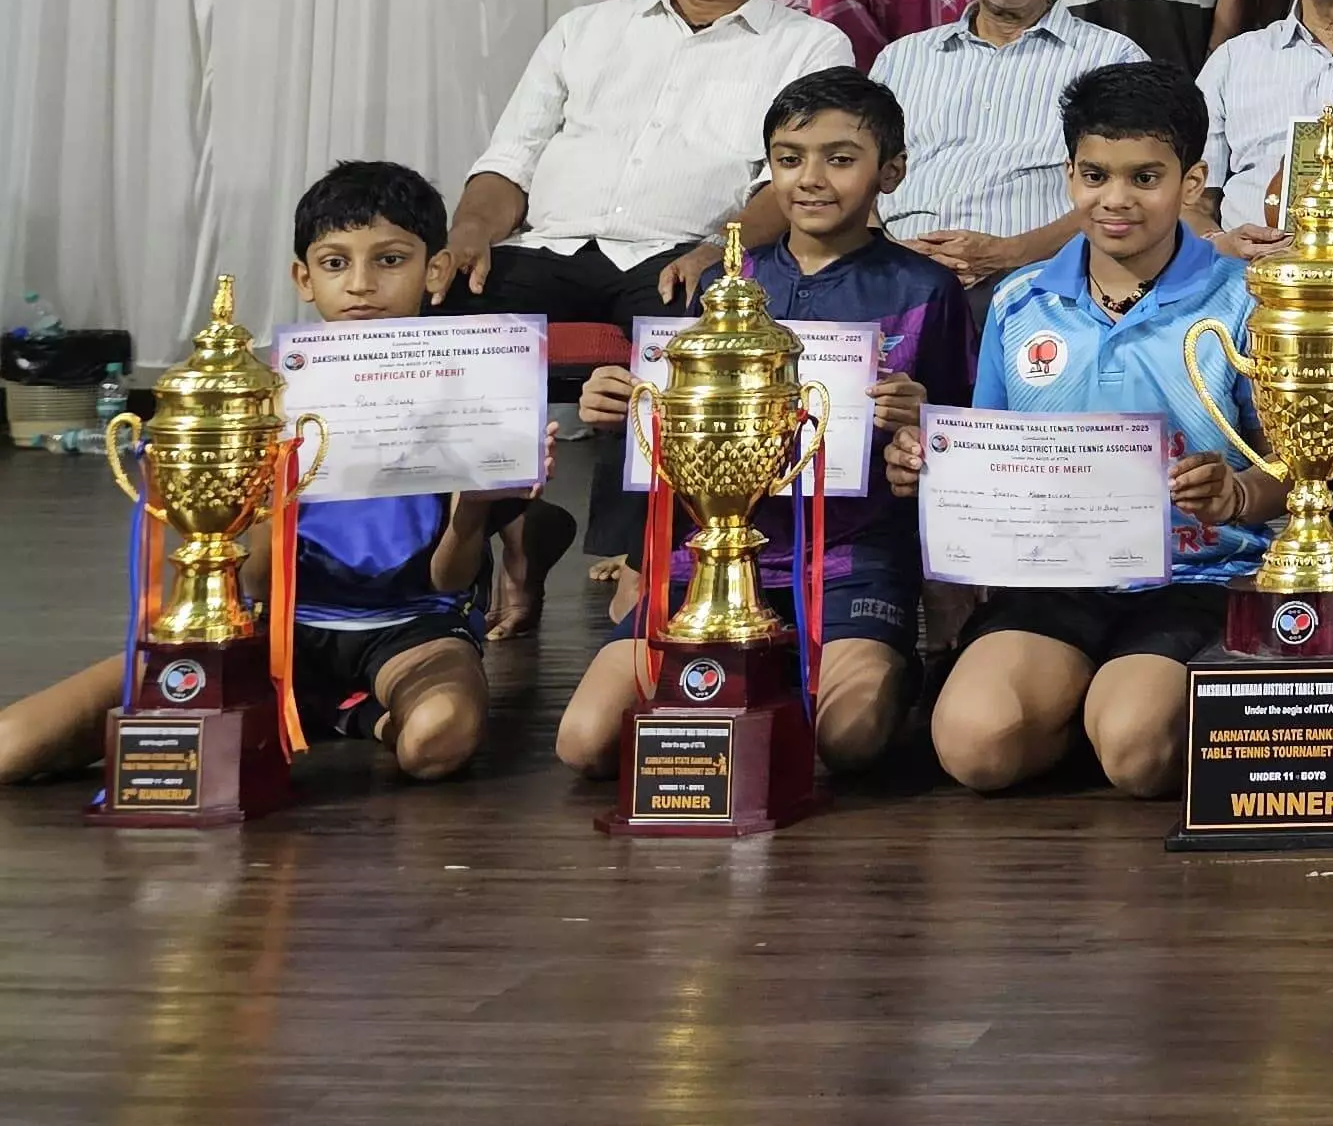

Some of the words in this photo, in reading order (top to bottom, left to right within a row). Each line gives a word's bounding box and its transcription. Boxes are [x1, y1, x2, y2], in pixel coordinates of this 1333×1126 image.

[313, 354, 350, 363] DAKSHINA
[391, 350, 425, 359] DISTRICT
[428, 349, 450, 358] TABLE
[453, 348, 479, 356] TENNIS
[482, 346, 530, 355] ASSOCIATION
[354, 370, 416, 382] CERTIFICATE
[420, 369, 432, 379] OF
[436, 368, 466, 377] MERIT
[990, 463, 1045, 473] CERTIFICATE
[1049, 464, 1061, 473] OF
[1064, 465, 1093, 473] MERIT
[1245, 706, 1268, 715] Under
[1314, 705, 1333, 713] KTTA
[1210, 729, 1270, 742] KARNATAKA
[1272, 729, 1303, 741] STATE
[1201, 747, 1232, 759] TABLE
[1235, 747, 1270, 759] TENNIS
[1273, 746, 1332, 758] TOURNAMET
[1250, 773, 1281, 782] UNDER
[1283, 772, 1294, 781] 11
[1301, 771, 1326, 780] BOYS
[652, 796, 710, 809] RUNNER
